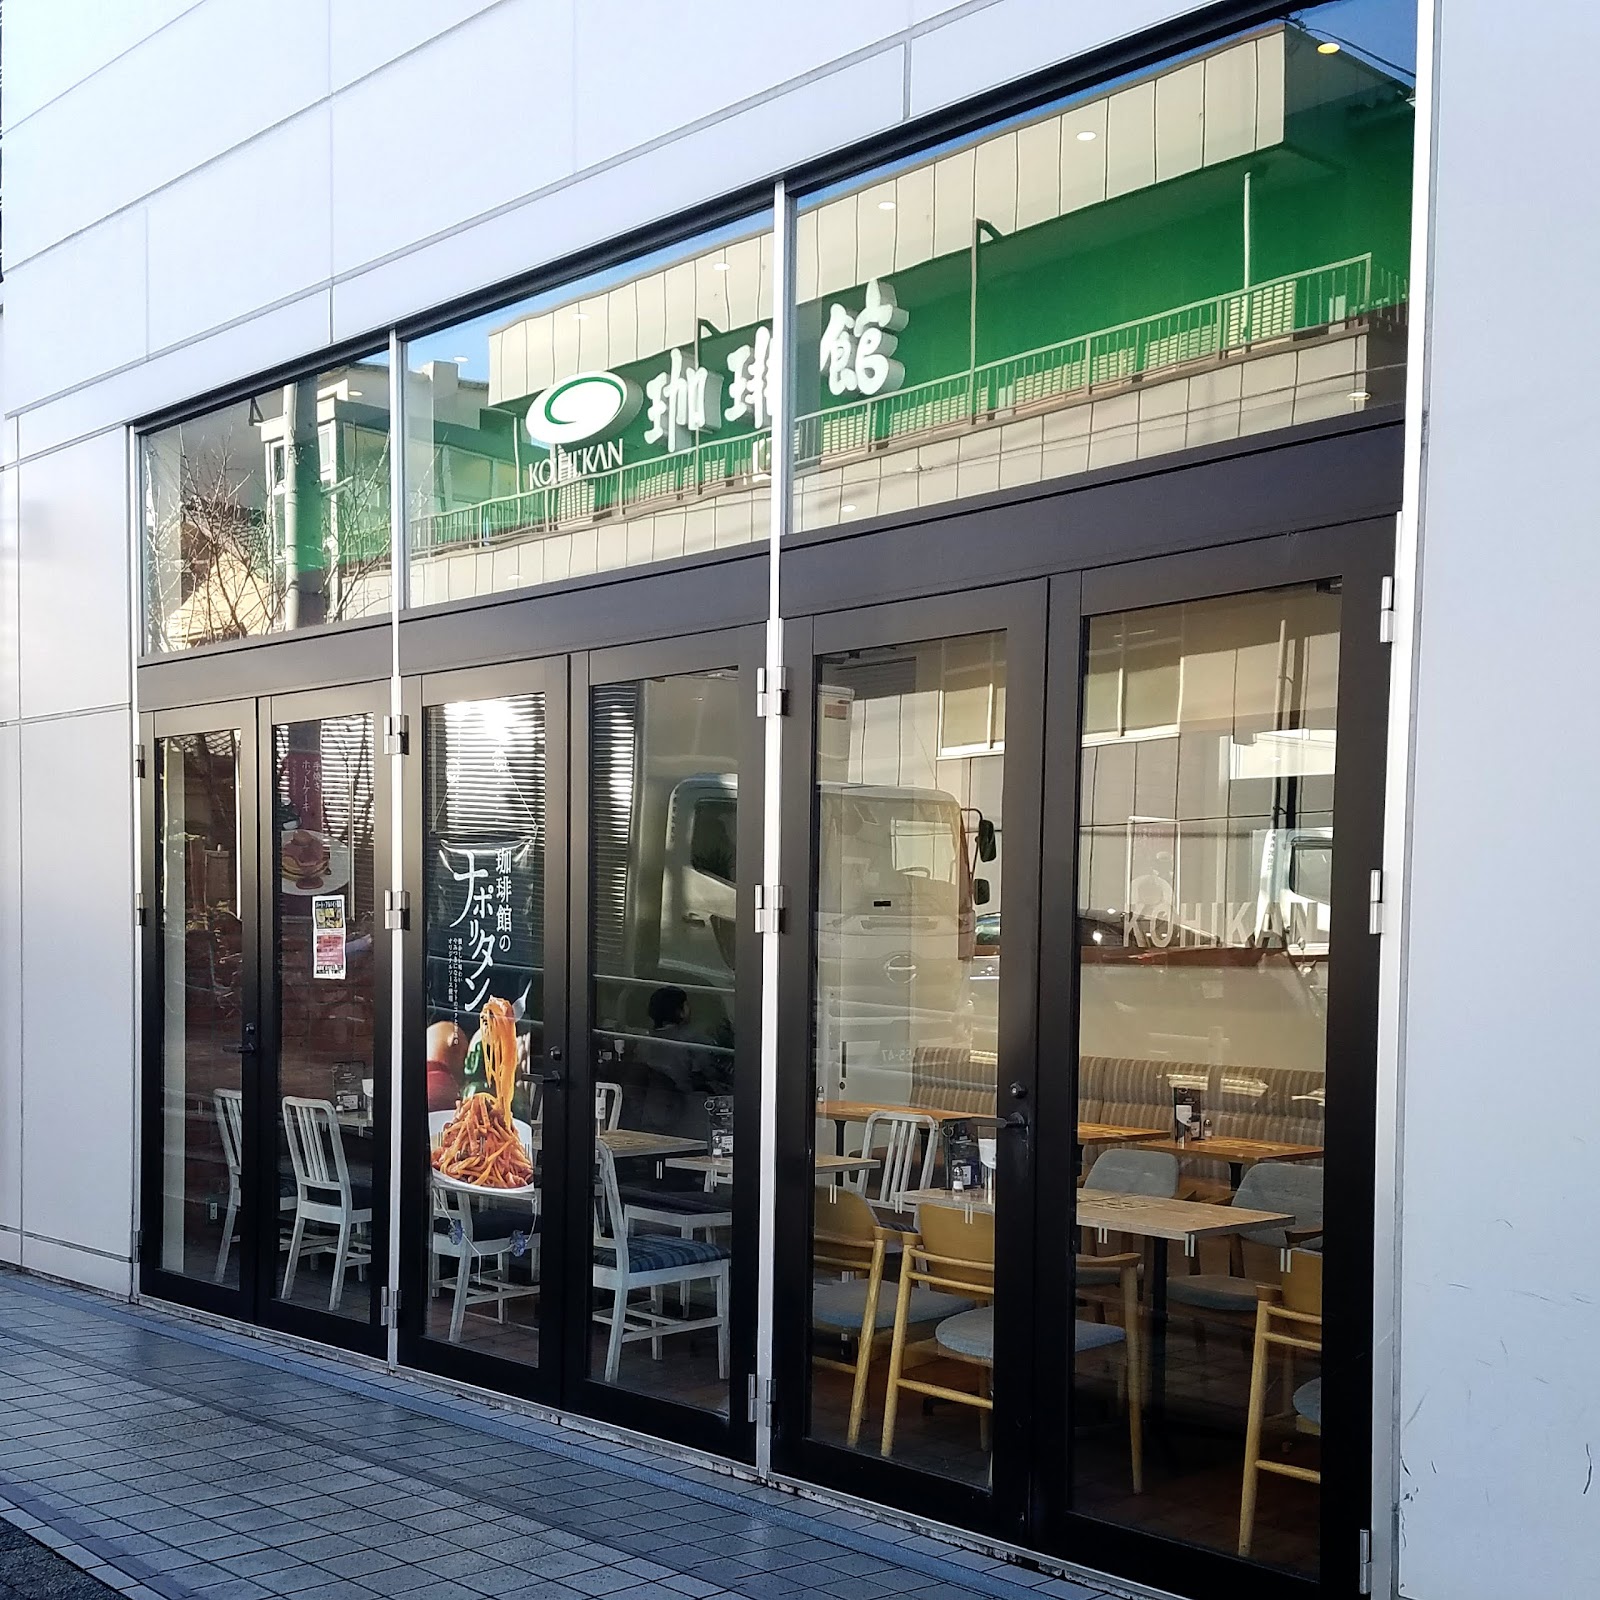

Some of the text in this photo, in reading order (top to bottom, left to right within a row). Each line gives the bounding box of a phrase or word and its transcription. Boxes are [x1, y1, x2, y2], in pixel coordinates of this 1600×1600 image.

[642, 278, 900, 452] 珈琲館
[301, 760, 311, 812] ホットケーキ
[312, 761, 322, 792] 手焼き
[449, 851, 496, 1012] ナポリタン
[495, 847, 513, 952] 珈琲館の
[1123, 902, 1319, 948] KOHIKAN
